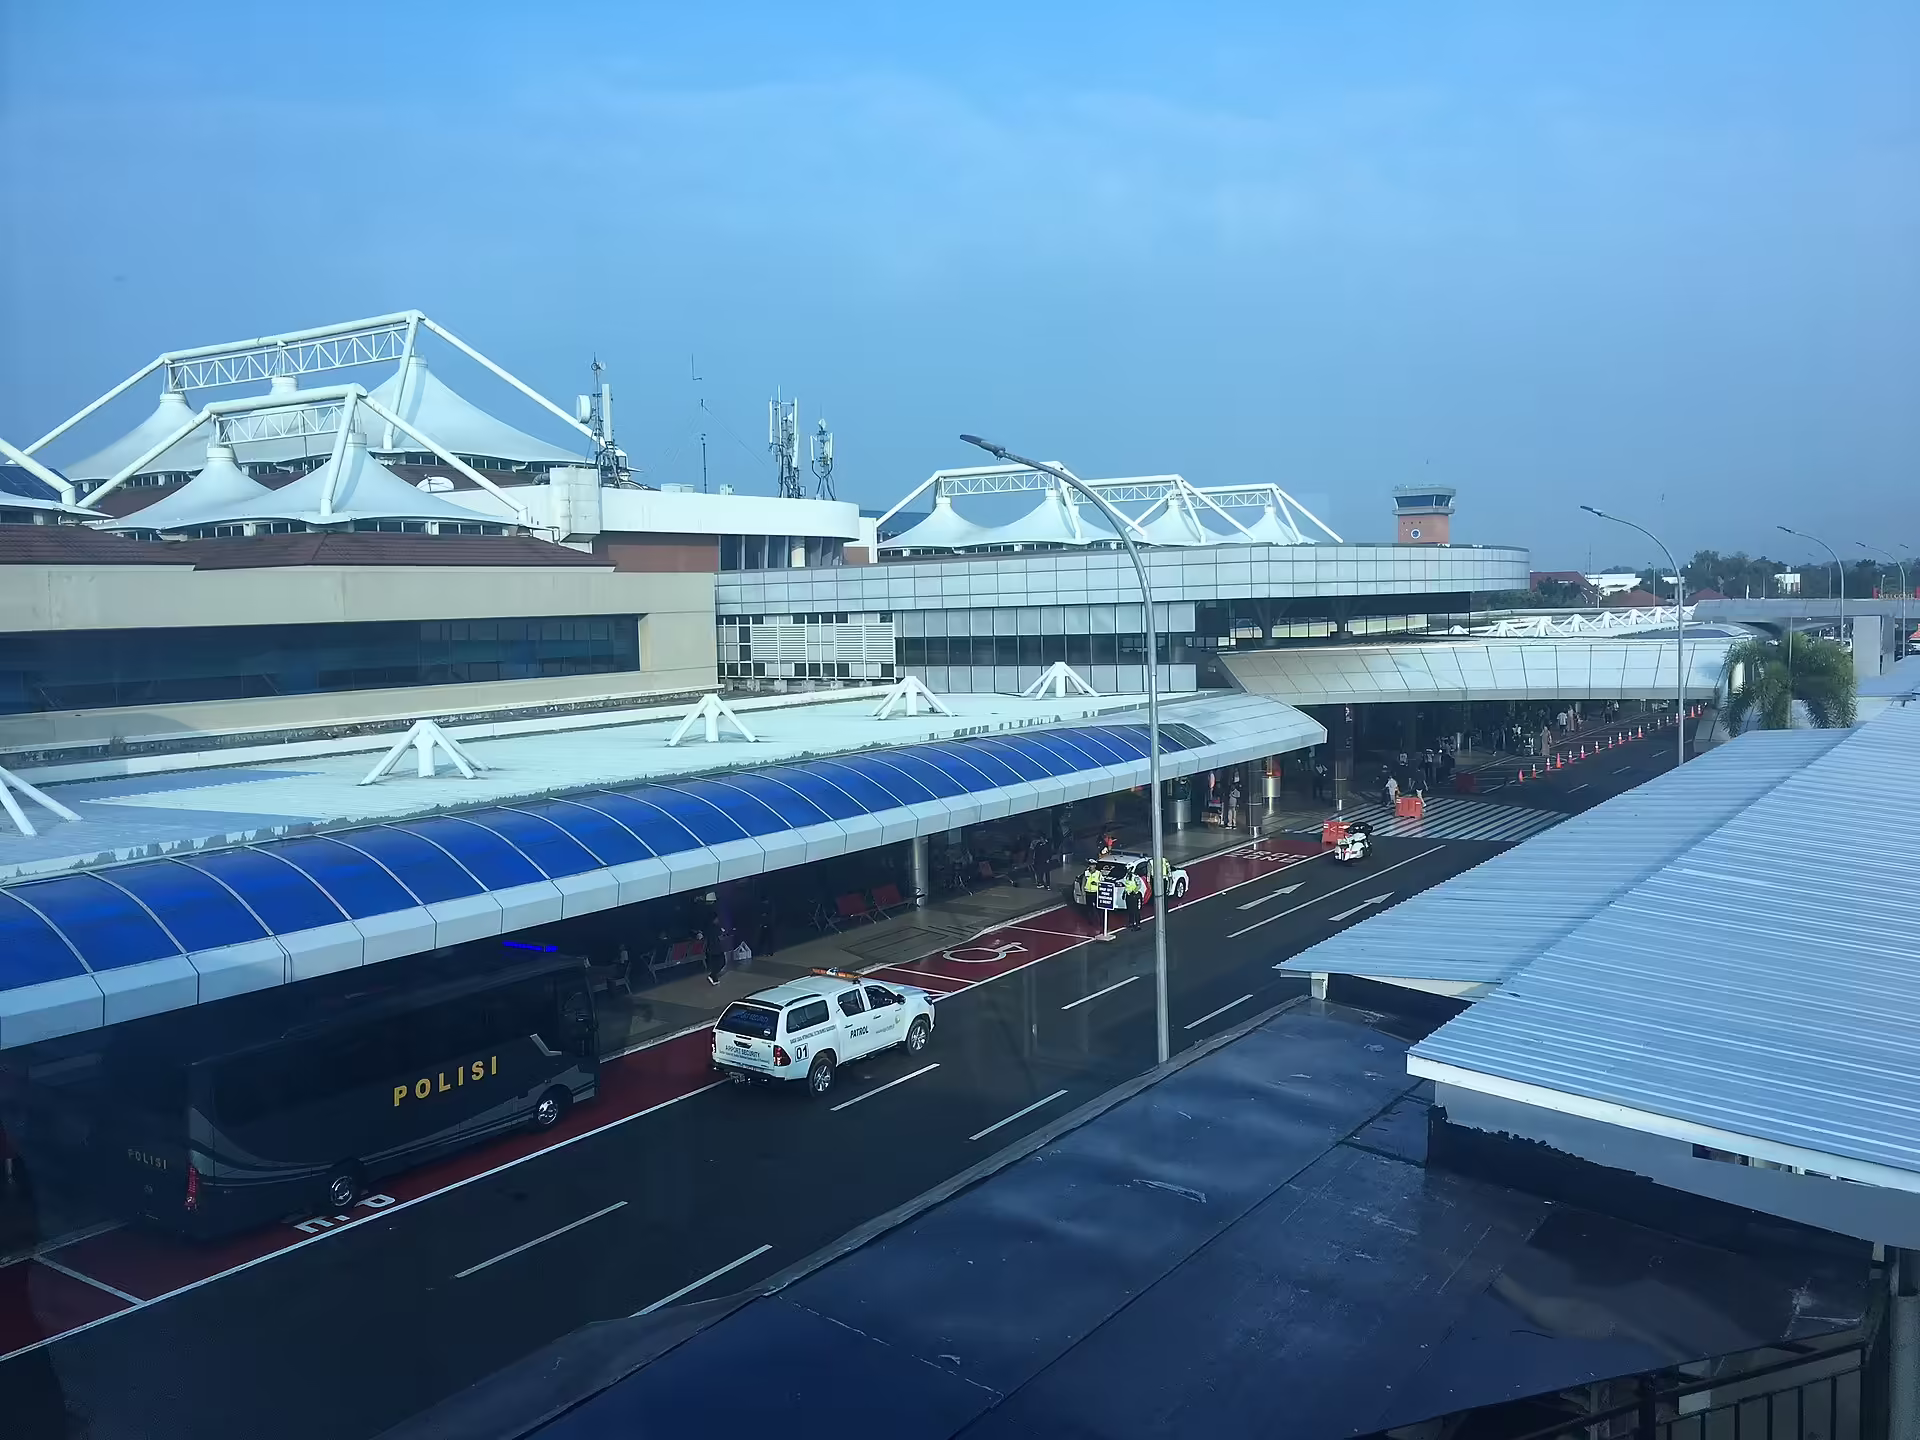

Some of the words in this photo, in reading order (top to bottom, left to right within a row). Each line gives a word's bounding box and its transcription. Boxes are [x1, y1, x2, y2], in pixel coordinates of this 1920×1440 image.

[1224, 852, 1299, 864] ZONE
[1235, 849, 1308, 858] DROP
[849, 1025, 870, 1039] PATROL
[741, 1048, 761, 1058] SECURITY
[796, 1045, 808, 1059] 01
[393, 1055, 498, 1107] POLISI
[127, 1148, 168, 1170] POLISI
